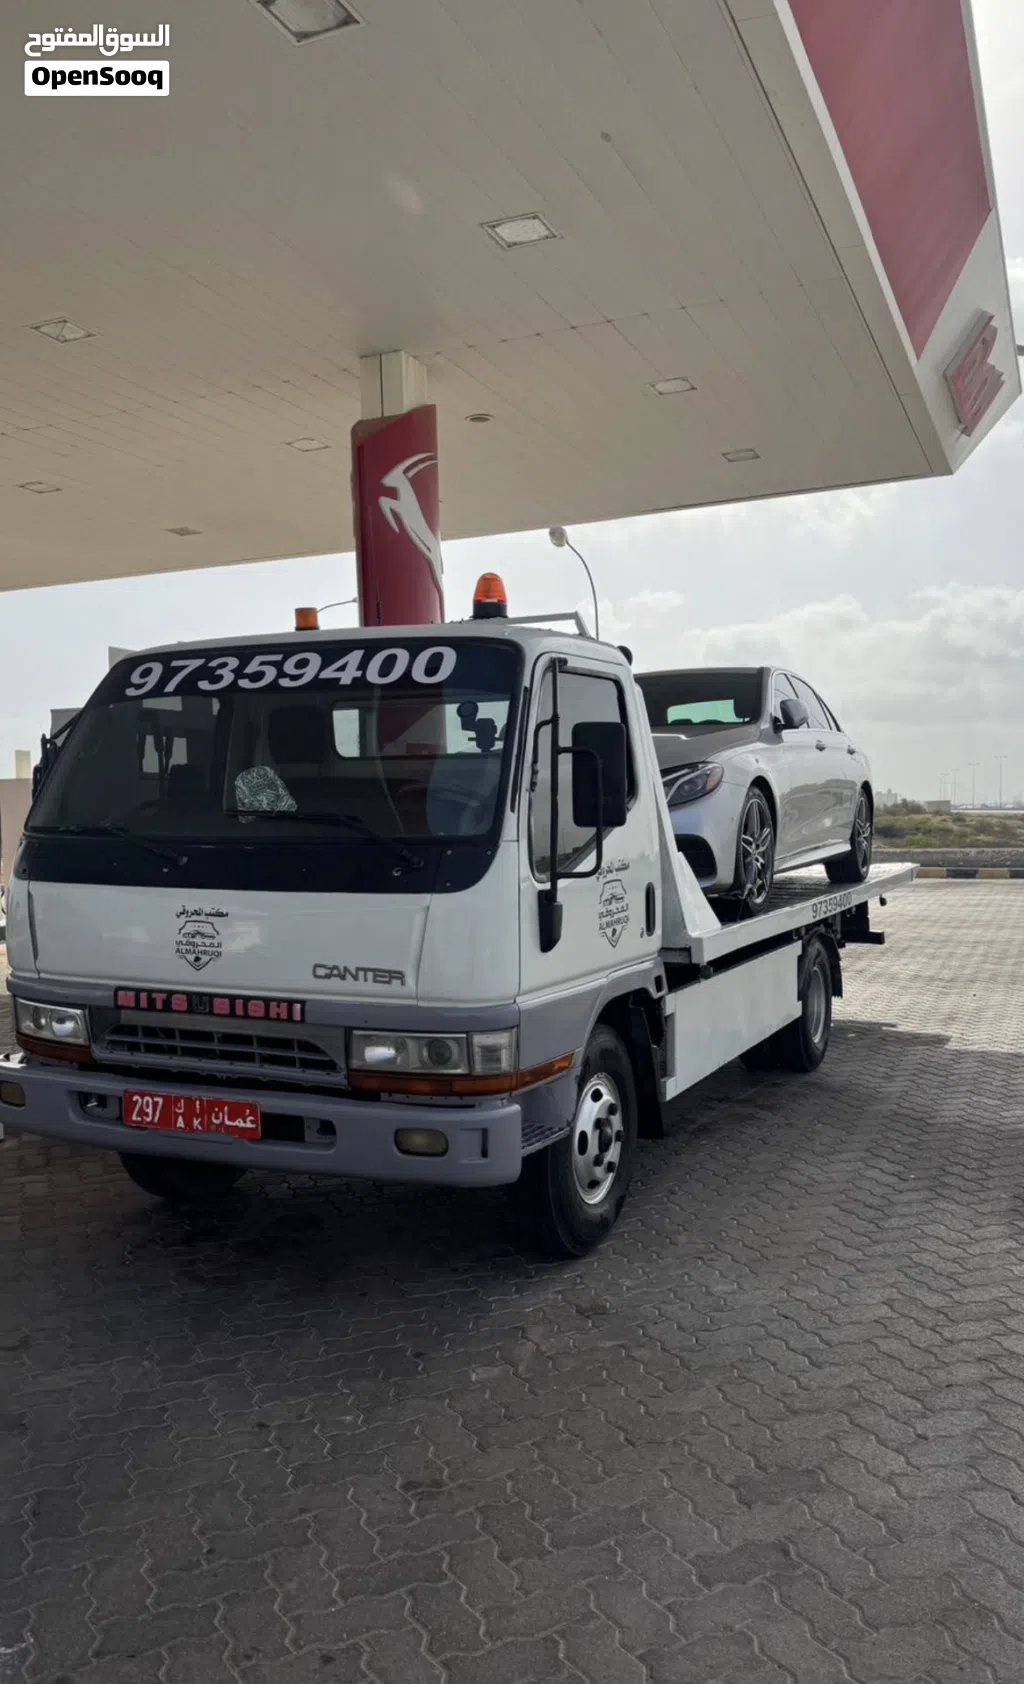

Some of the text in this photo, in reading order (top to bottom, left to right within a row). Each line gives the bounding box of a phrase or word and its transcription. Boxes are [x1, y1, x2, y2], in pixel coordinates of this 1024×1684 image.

[125, 646, 457, 697] 97359400
[811, 891, 853, 919] 97359400
[175, 947, 223, 958] ALMAHRUQI
[312, 963, 406, 986] CANTER
[117, 990, 302, 1022] MITSUBISHI
[131, 1095, 164, 1123] 297
